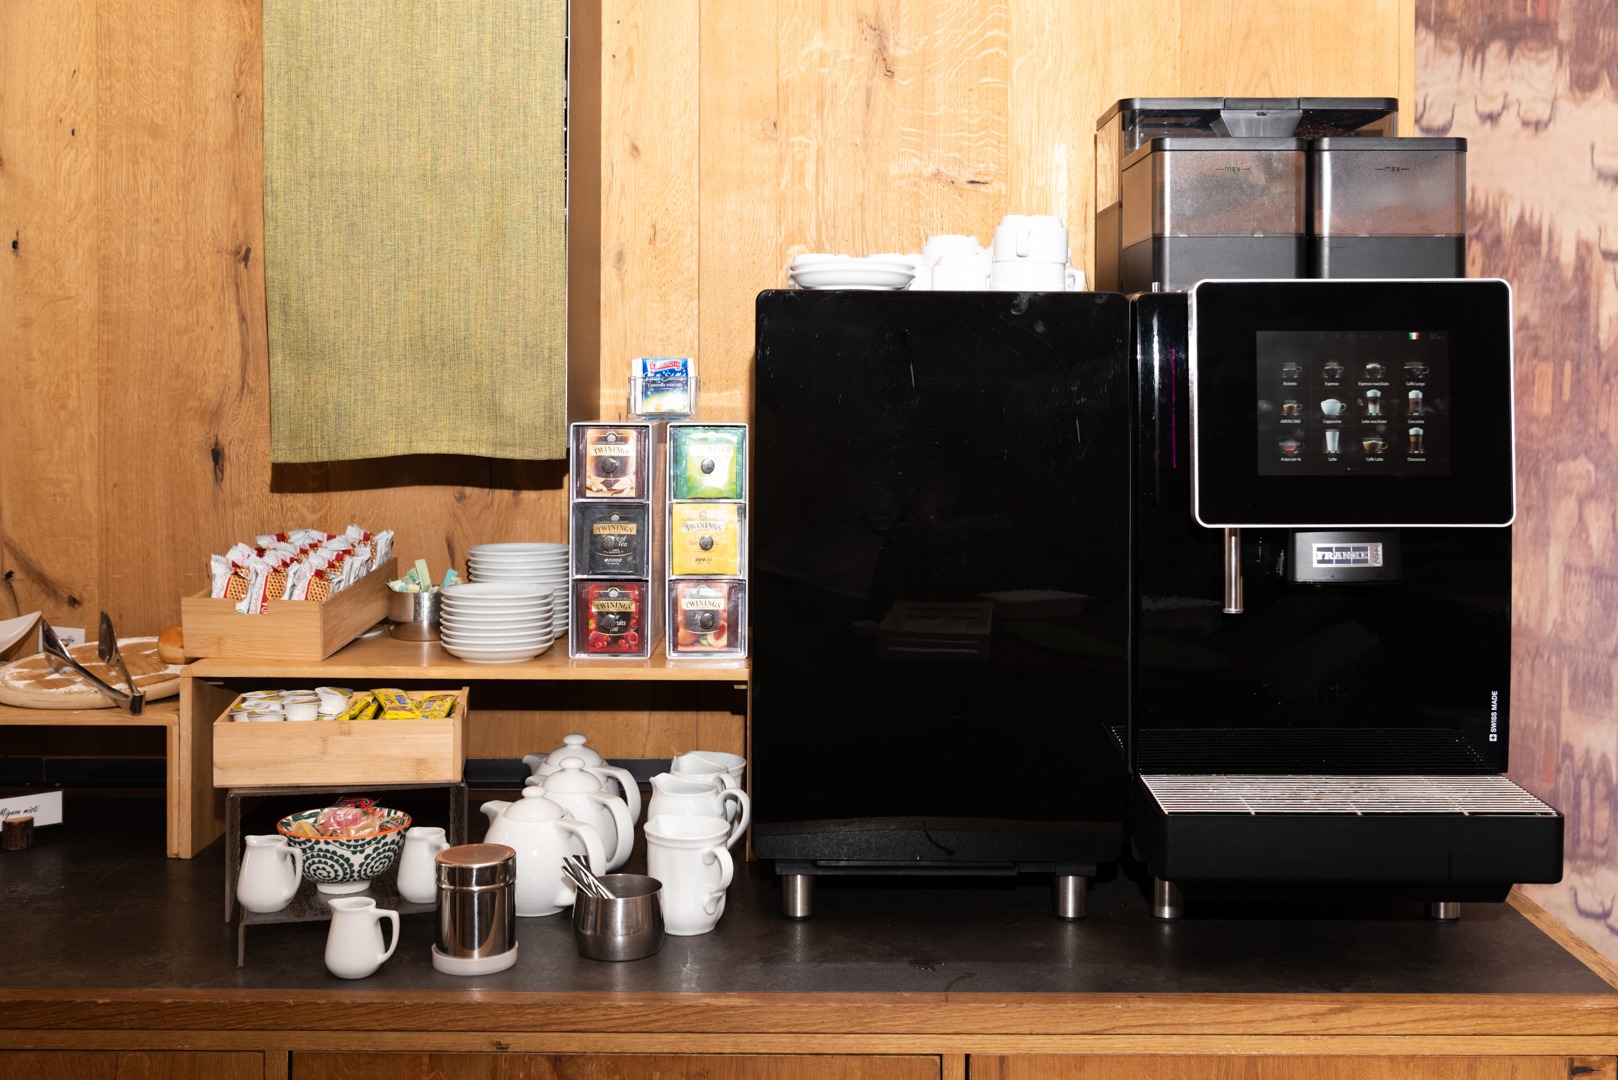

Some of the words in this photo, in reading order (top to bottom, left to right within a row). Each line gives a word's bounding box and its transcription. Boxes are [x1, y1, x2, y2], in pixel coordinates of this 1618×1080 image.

[596, 524, 634, 533] TWININGS
[685, 521, 722, 531] TWININGS
[1316, 550, 1369, 561] FRANKE
[596, 601, 632, 610] TWININGS
[686, 599, 721, 609] TWININGS
[1490, 711, 1498, 733] SWISS
